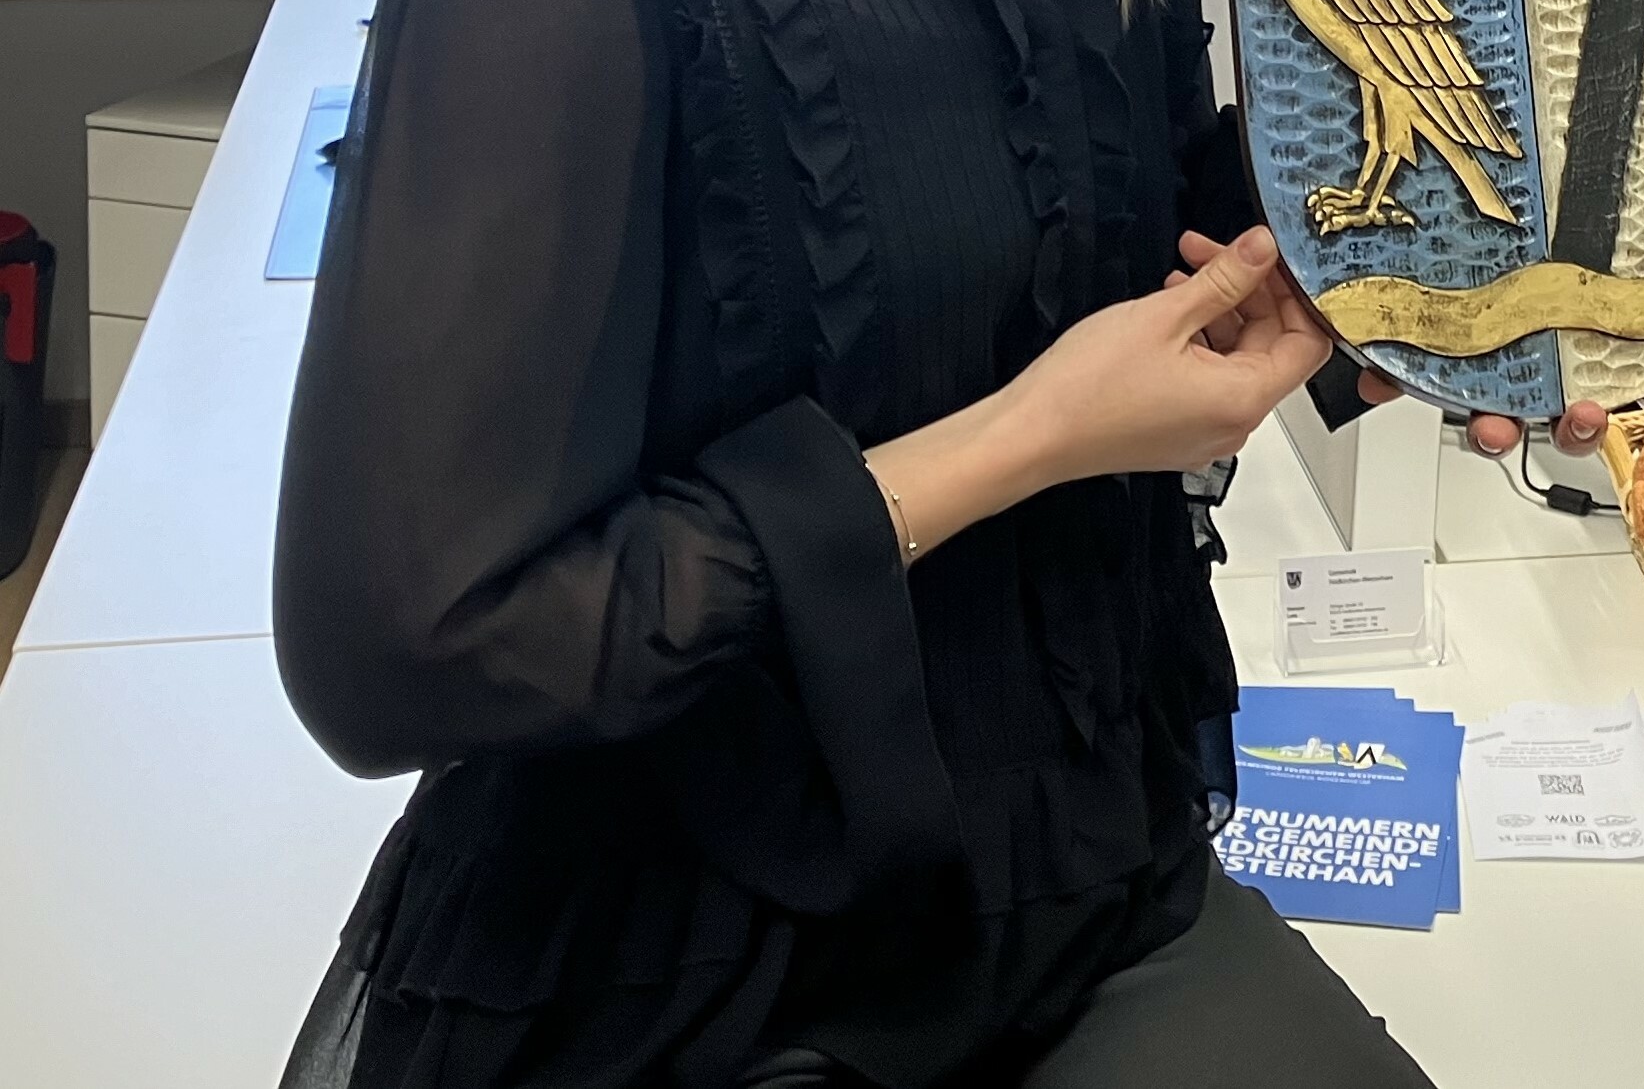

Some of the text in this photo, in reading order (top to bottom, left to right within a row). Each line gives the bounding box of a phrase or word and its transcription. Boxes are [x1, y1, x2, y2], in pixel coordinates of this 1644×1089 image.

[1233, 806, 1440, 840] FNUMMERN
[1212, 835, 1422, 871] LDKIRCHEN-
[1255, 826, 1439, 857] GEMEINDE
